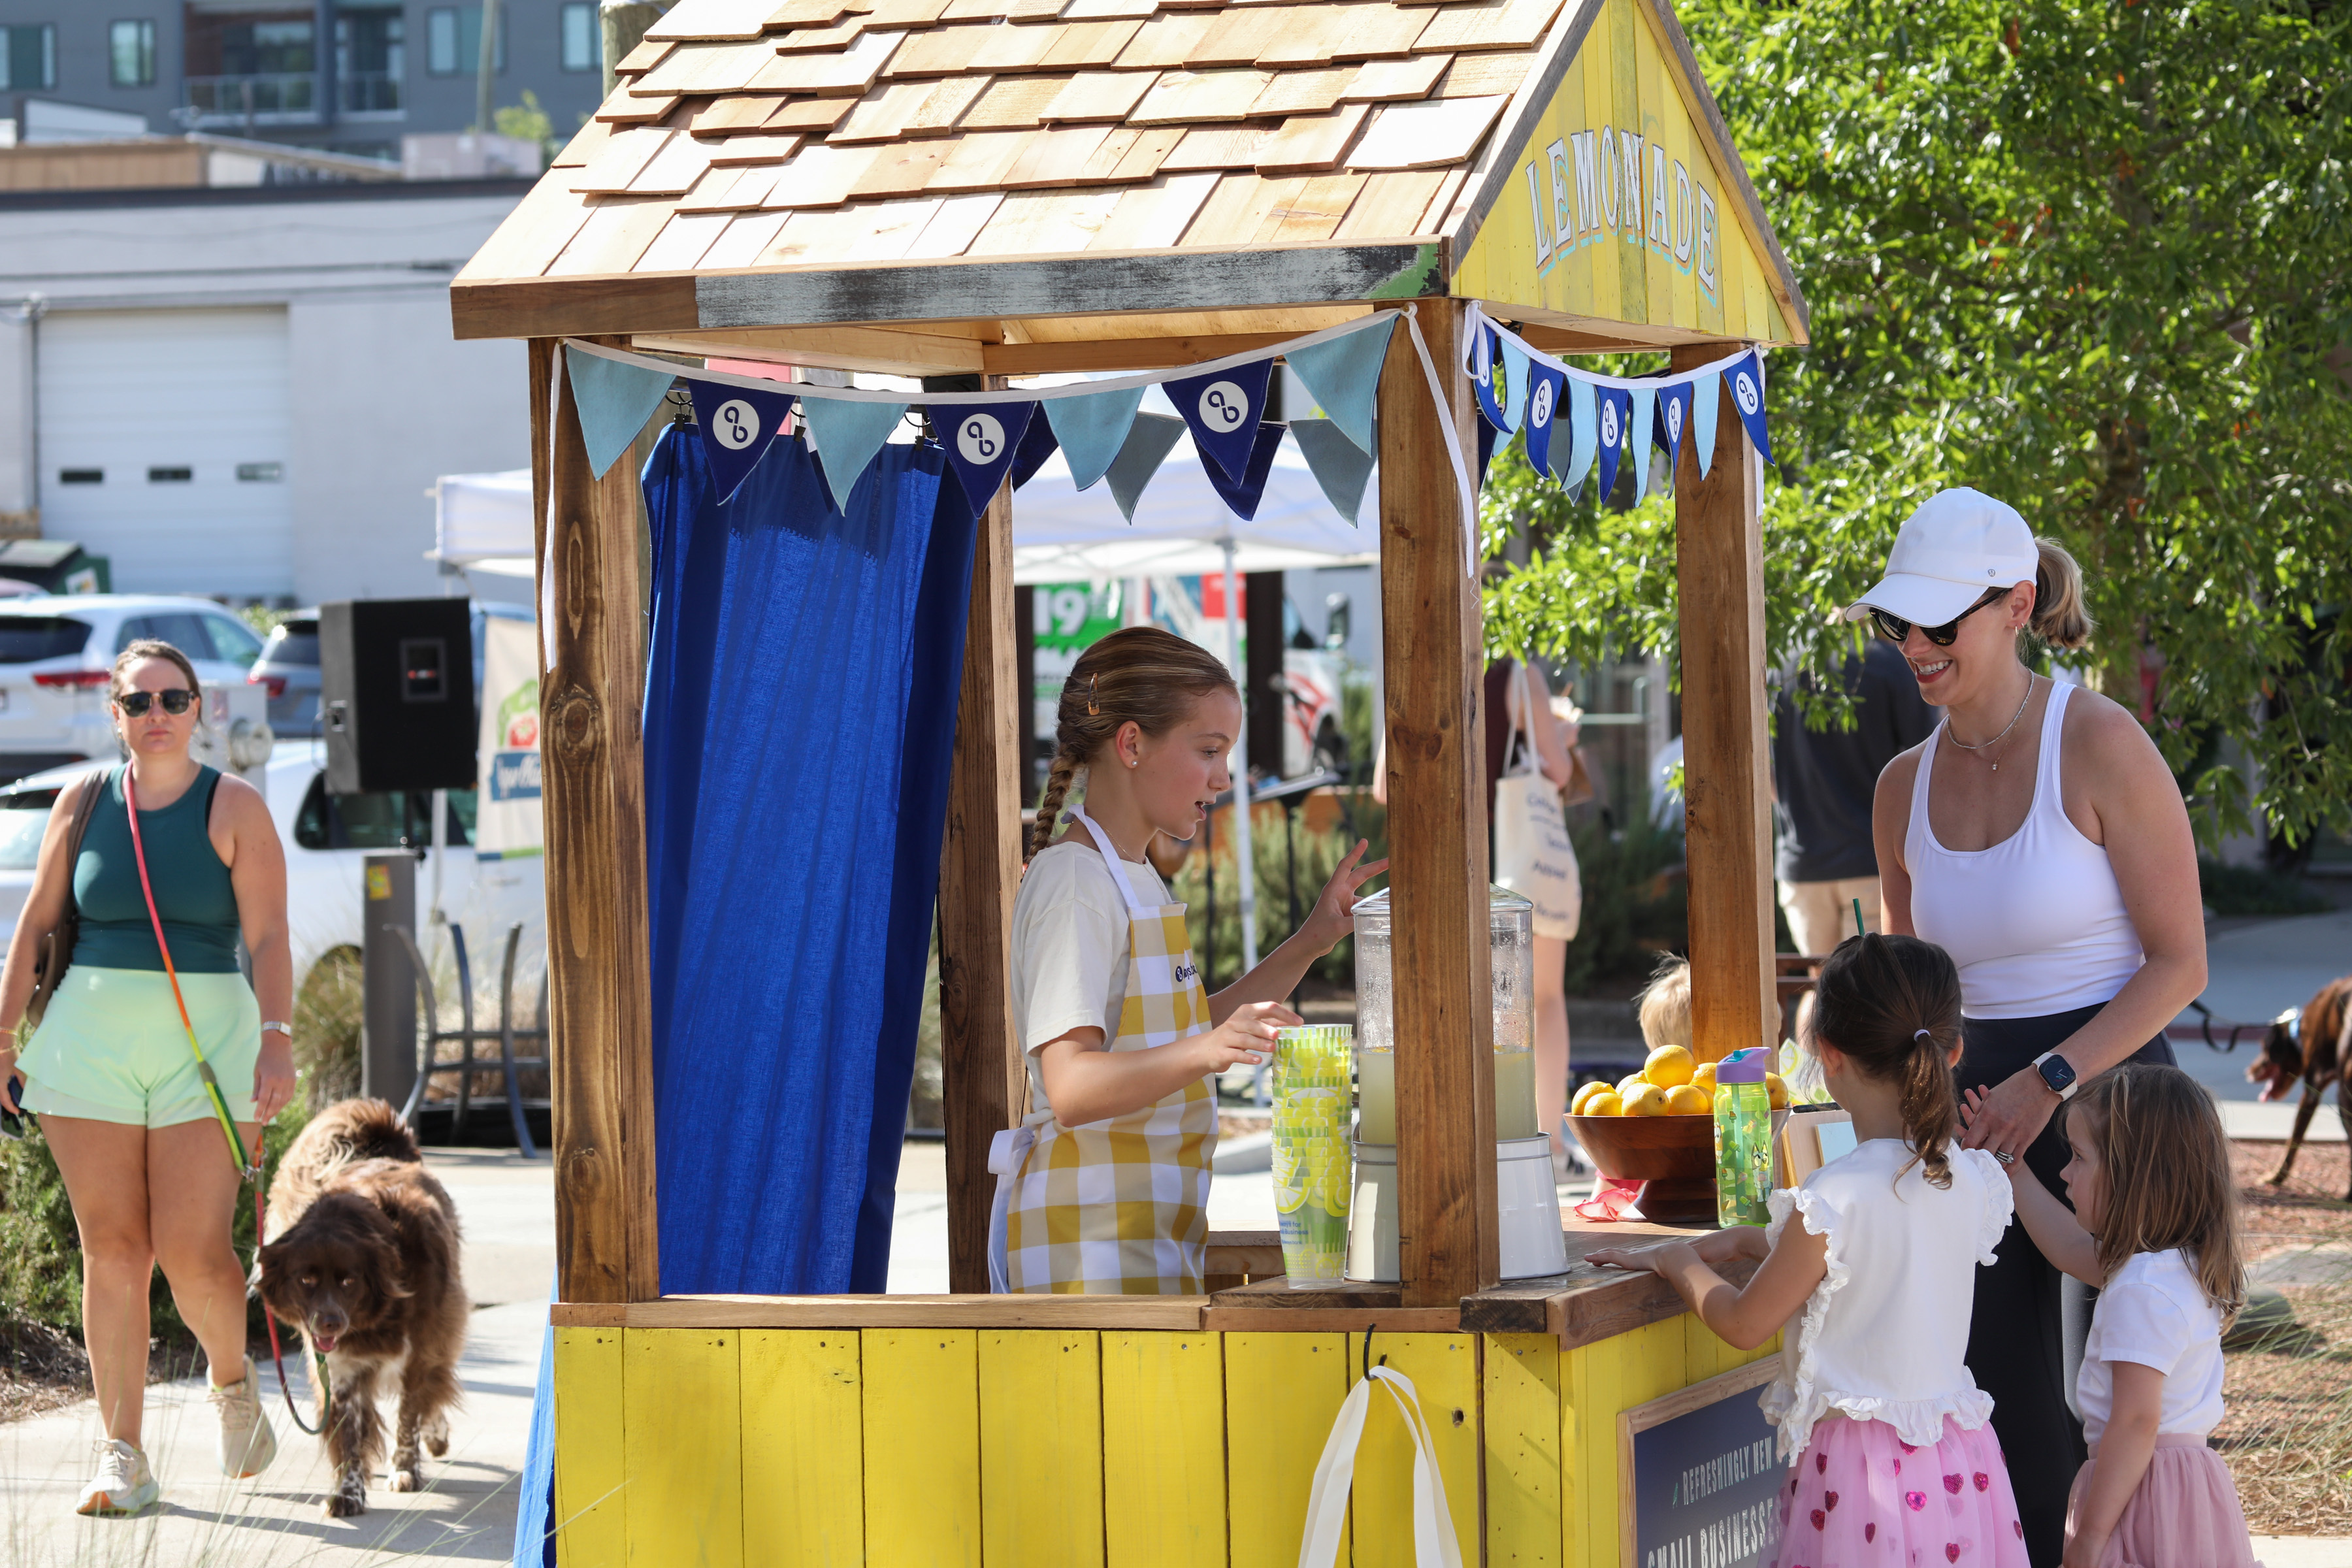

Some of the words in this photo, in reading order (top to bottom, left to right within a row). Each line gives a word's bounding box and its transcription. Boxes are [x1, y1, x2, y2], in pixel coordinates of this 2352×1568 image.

[1526, 124, 1716, 295] LEMONADE
[1683, 1445, 1750, 1506] REFRESHINGLY
[1753, 1435, 1772, 1475] NEW
